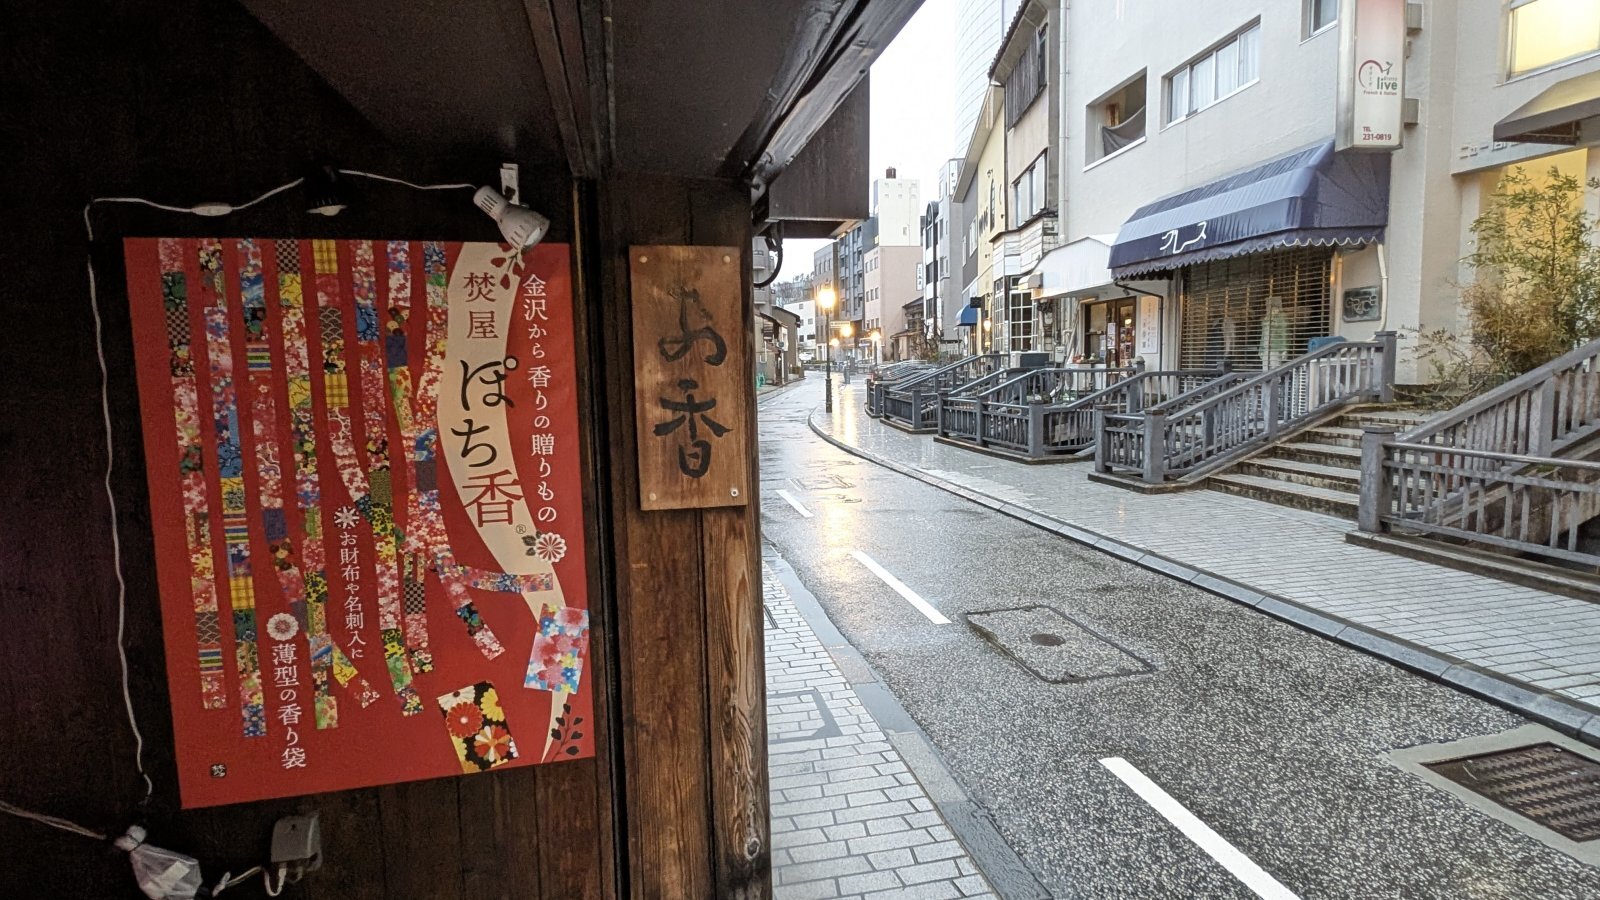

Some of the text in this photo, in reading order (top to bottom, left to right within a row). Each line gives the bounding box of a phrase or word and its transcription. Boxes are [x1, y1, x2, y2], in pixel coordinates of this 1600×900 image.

[1362, 133, 1392, 141] 231-0819
[463, 271, 499, 340] 焚屋
[450, 355, 524, 528] ぽち香
[522, 274, 557, 523] 金沢から香りの贈りもの
[653, 286, 733, 479] お香
[339, 531, 366, 659] お財布や名刺入に
[272, 643, 307, 769] 薄型の香り袋
